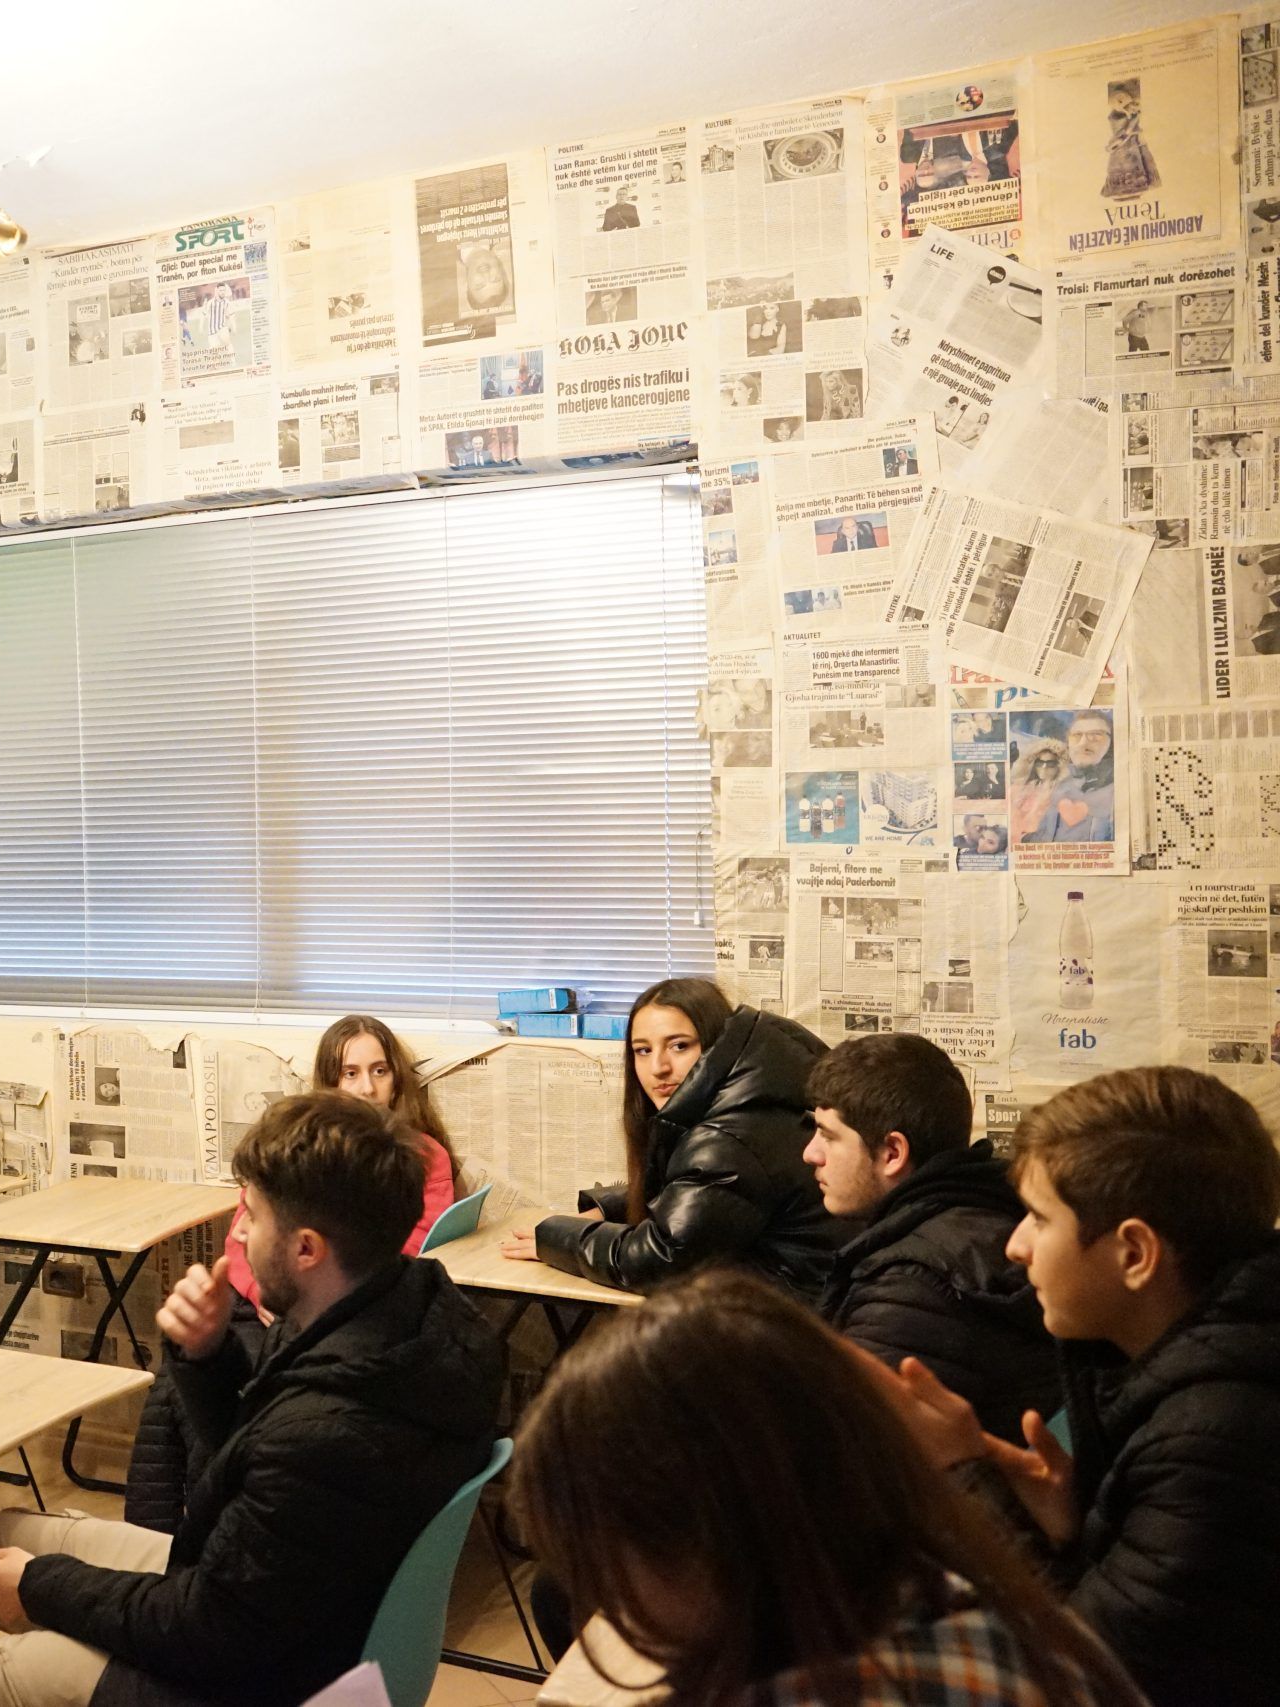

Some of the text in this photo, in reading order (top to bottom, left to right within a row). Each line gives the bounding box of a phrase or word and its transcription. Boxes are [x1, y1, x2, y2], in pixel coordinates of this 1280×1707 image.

[705, 119, 732, 129] KULTURE
[555, 162, 572, 171] Luan
[574, 158, 598, 167] Rama:
[600, 152, 626, 164] Grushti
[633, 147, 658, 157] shtetit
[555, 172, 568, 181] nuk
[593, 165, 616, 174] vetëm
[618, 162, 630, 171] kur
[633, 159, 644, 168] del
[556, 168, 657, 190] tanke dhe sulmon qeverinë
[920, 180, 1017, 202] Ilir Metën për ligjet
[908, 191, 1018, 215] I dënuari që këshillon
[175, 220, 245, 252] SPORT
[968, 230, 1013, 248] Tem
[1069, 215, 1204, 252] ABONOHU NË GAZETËN
[181, 260, 196, 269] Duel
[199, 254, 224, 266] special
[156, 262, 243, 283] Tiranën, por fiton Kukësi
[1057, 267, 1235, 295] Troisi: Flamurtari nuk dorëzohet
[930, 352, 996, 392] që ndodhin në trupin
[937, 340, 975, 365] Ndryshimet
[979, 360, 1012, 383] papritura
[557, 367, 689, 397] Pas drogës nis trafiku i
[923, 365, 993, 407] e një gruaje pas lindjes
[557, 388, 690, 415] mbetjeve kancerogjene
[1198, 464, 1210, 498] dyshime:
[1210, 463, 1218, 479] kem
[713, 478, 731, 487] 35%
[776, 504, 794, 513] Anija
[807, 499, 833, 509] mbetje,
[835, 493, 866, 504] Panariti:
[877, 488, 900, 497] bëhen
[1210, 491, 1218, 505] dua
[1223, 491, 1231, 508] luftë
[776, 513, 800, 522] shpejt
[835, 505, 853, 514] edhe
[855, 501, 876, 510] Italia
[1198, 518, 1208, 540] Zidan
[1210, 507, 1219, 540] Ramosin
[1223, 524, 1231, 534] në
[950, 586, 969, 620] Presidenti
[946, 621, 955, 638] ngre
[1212, 598, 1228, 648] LULZIM
[783, 632, 821, 641] AKTUALITET
[812, 647, 900, 660] 1600 mjekë dhe infermierë
[812, 656, 900, 671] të rinj, Orgerta Manastirliu:
[812, 670, 842, 680] Punësim
[854, 667, 900, 678] transparencë
[1215, 659, 1231, 699] LIDER
[809, 863, 883, 875] Bajerni, fitore me
[796, 876, 896, 888] vuajtje ndaj Paderbornit
[1179, 894, 1265, 904] ngecin në det, futën
[1191, 904, 1211, 913] skaf
[1212, 904, 1226, 915] për
[1228, 904, 1267, 915] peshkim
[1069, 966, 1085, 975] fab
[968, 1039, 994, 1047] Lefter
[1058, 1028, 1097, 1049] fab
[958, 1049, 986, 1057] SPAK
[988, 1109, 1022, 1123] Sport
